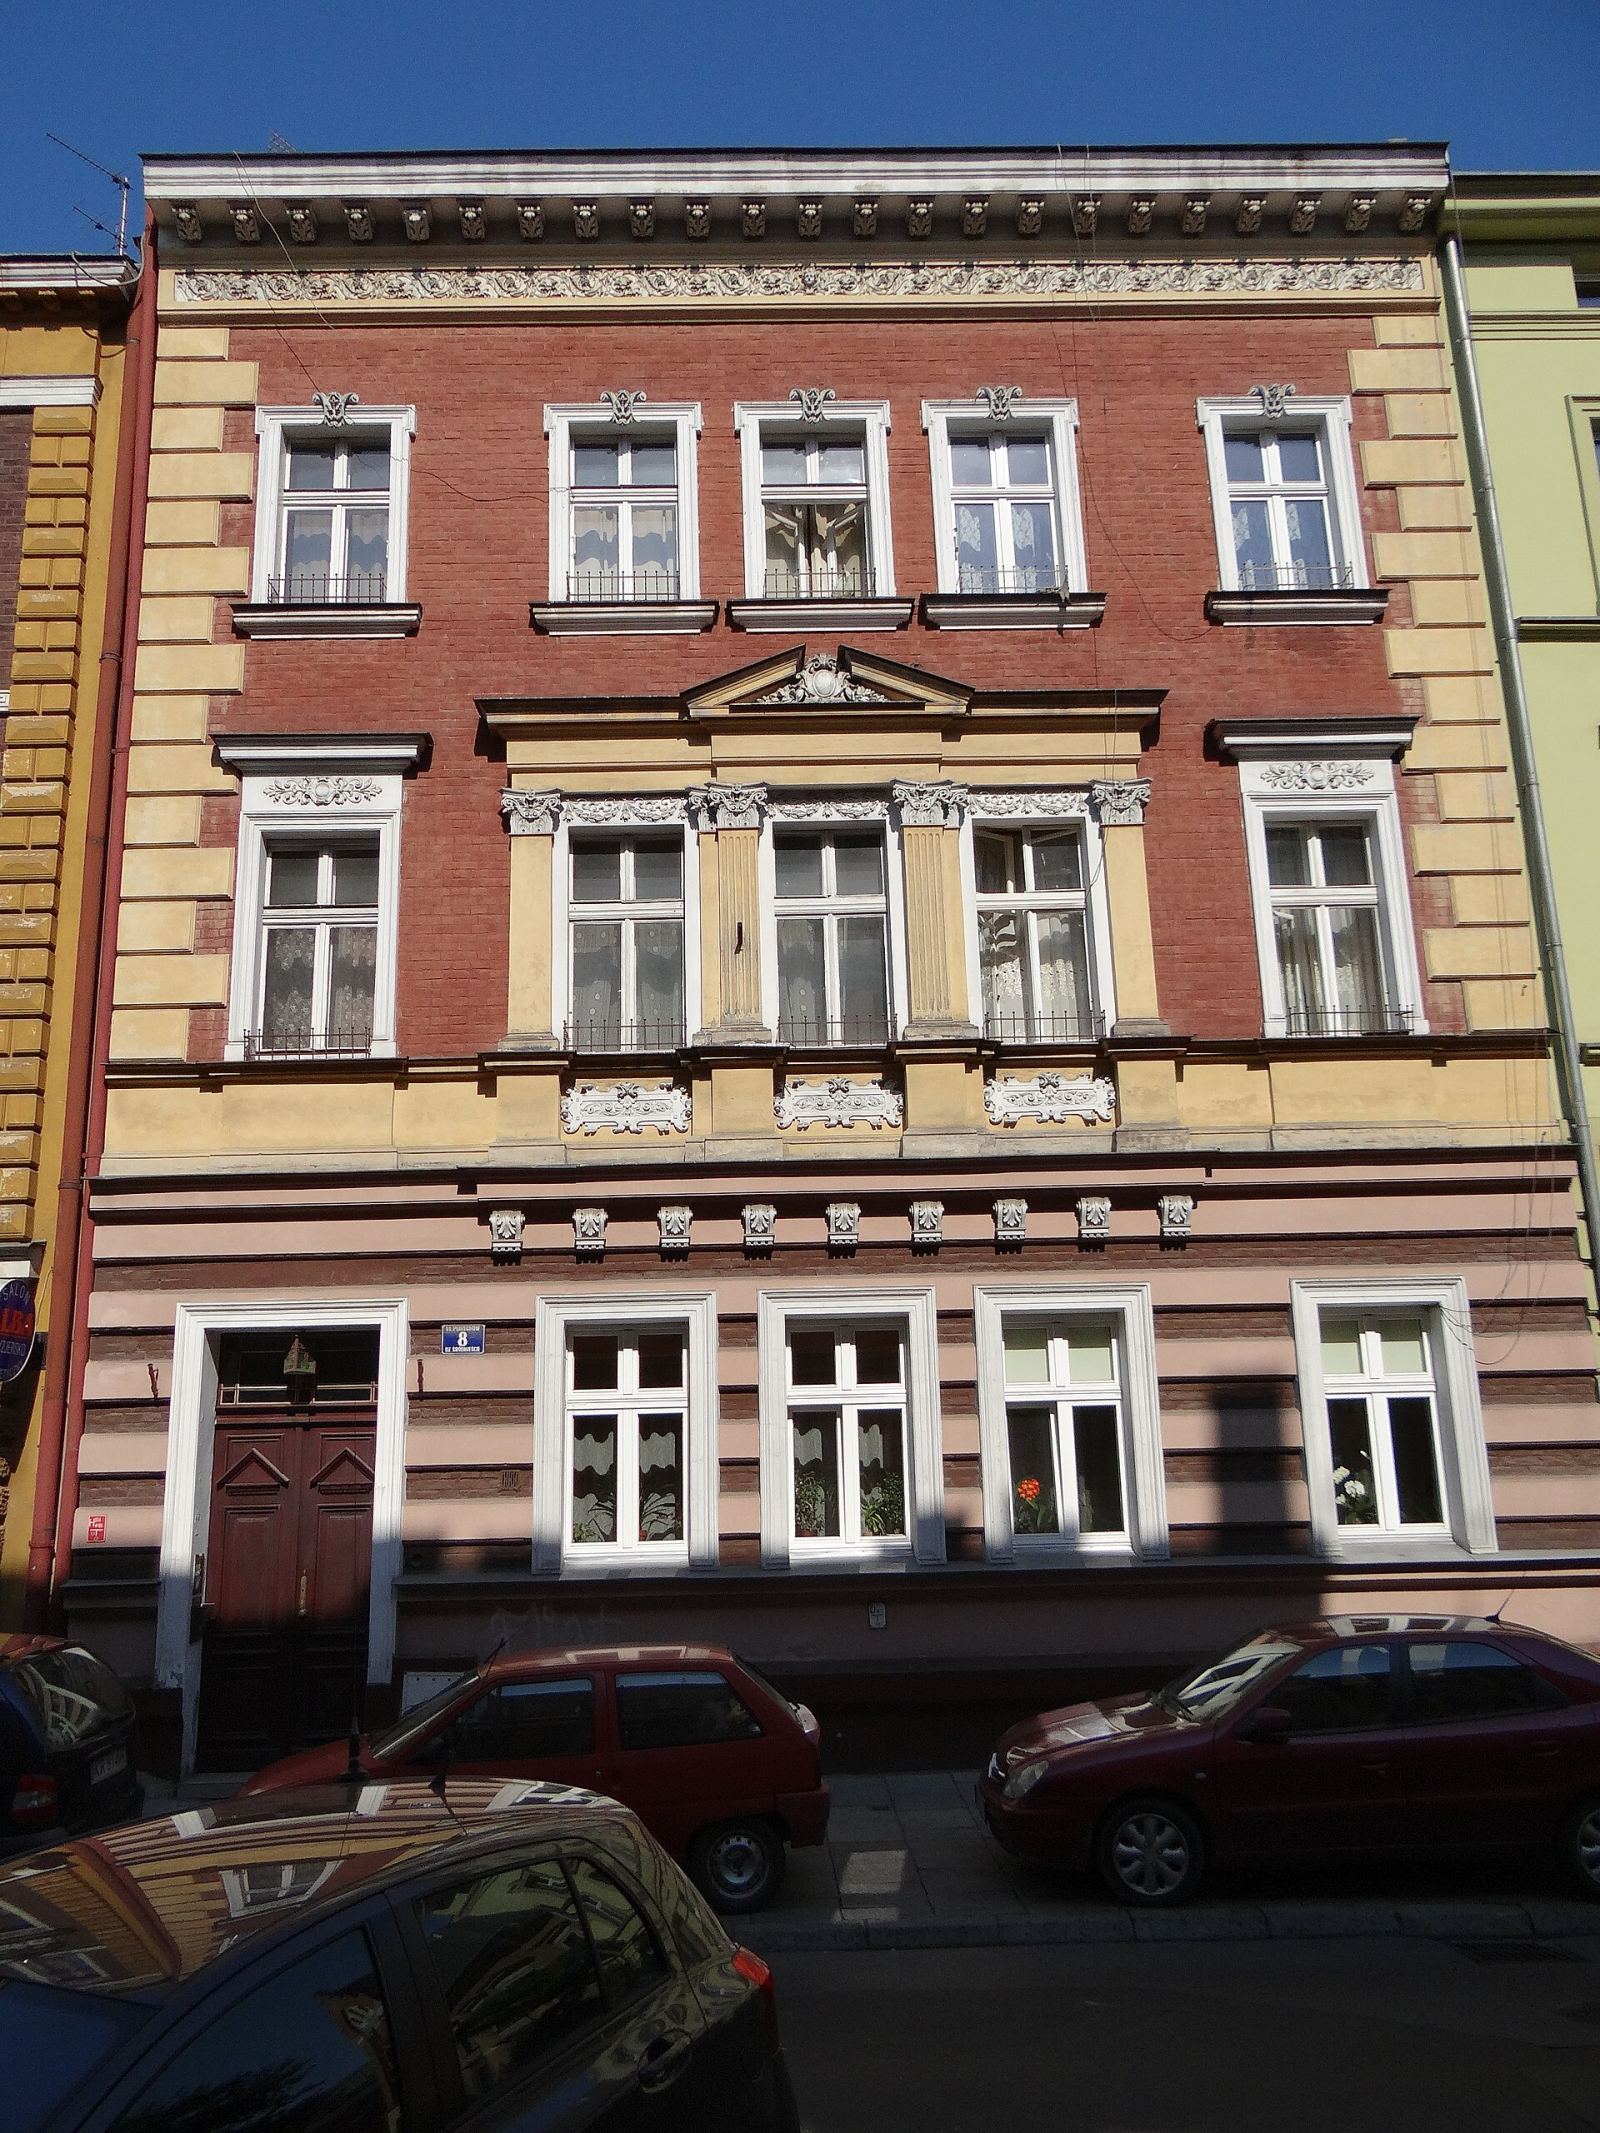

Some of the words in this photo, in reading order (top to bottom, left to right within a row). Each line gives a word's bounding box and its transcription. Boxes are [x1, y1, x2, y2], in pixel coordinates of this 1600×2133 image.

[3, 1282, 31, 1305] SALON
[0, 1308, 34, 1336] LBA
[457, 1331, 468, 1346] 8
